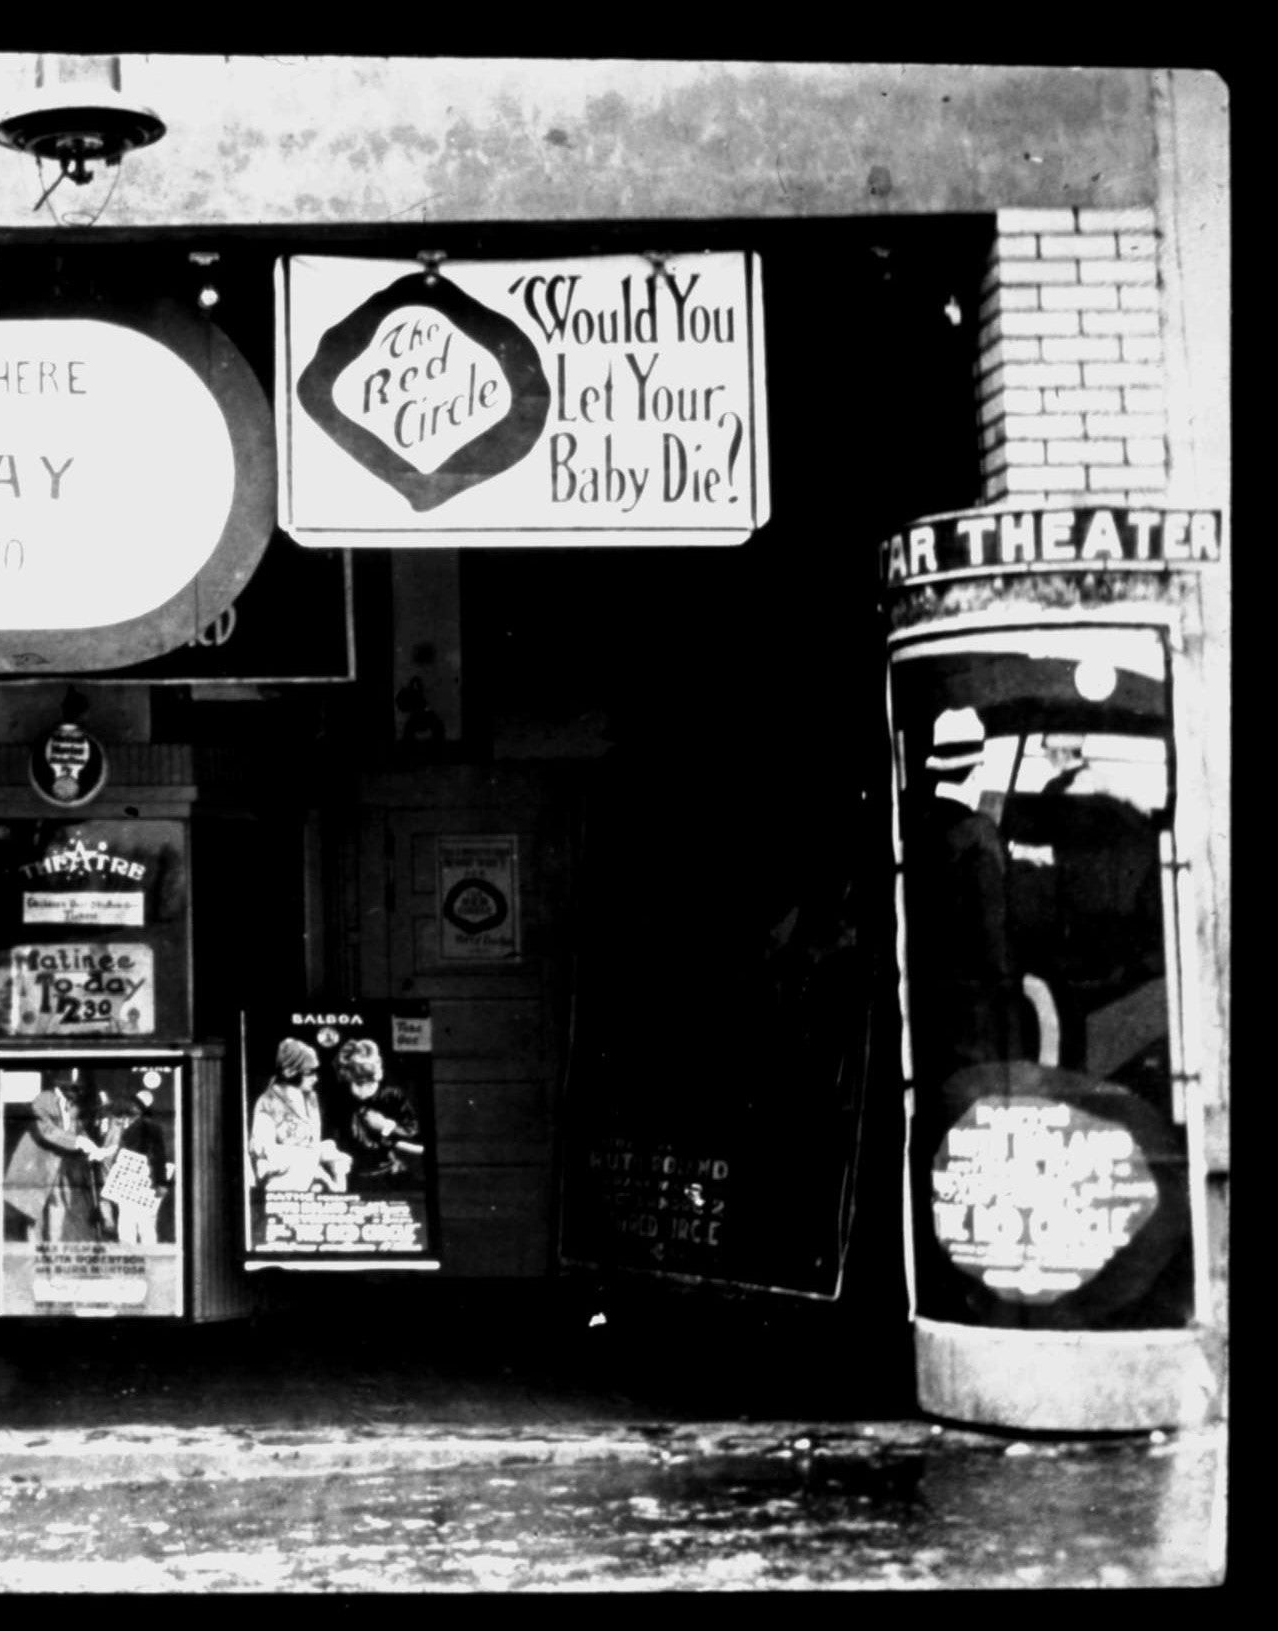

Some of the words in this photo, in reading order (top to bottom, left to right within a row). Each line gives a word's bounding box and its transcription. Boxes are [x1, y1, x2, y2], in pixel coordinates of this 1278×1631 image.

[380, 319, 441, 359] The
[665, 273, 736, 344] You
[362, 331, 456, 413] Red
[392, 362, 499, 449] Circle
[556, 353, 615, 423] Let
[624, 352, 726, 423] Your
[549, 432, 650, 513] Baby
[662, 412, 745, 504] Die?
[956, 509, 1221, 566] THEATER
[291, 1013, 364, 1026] BALBOA
